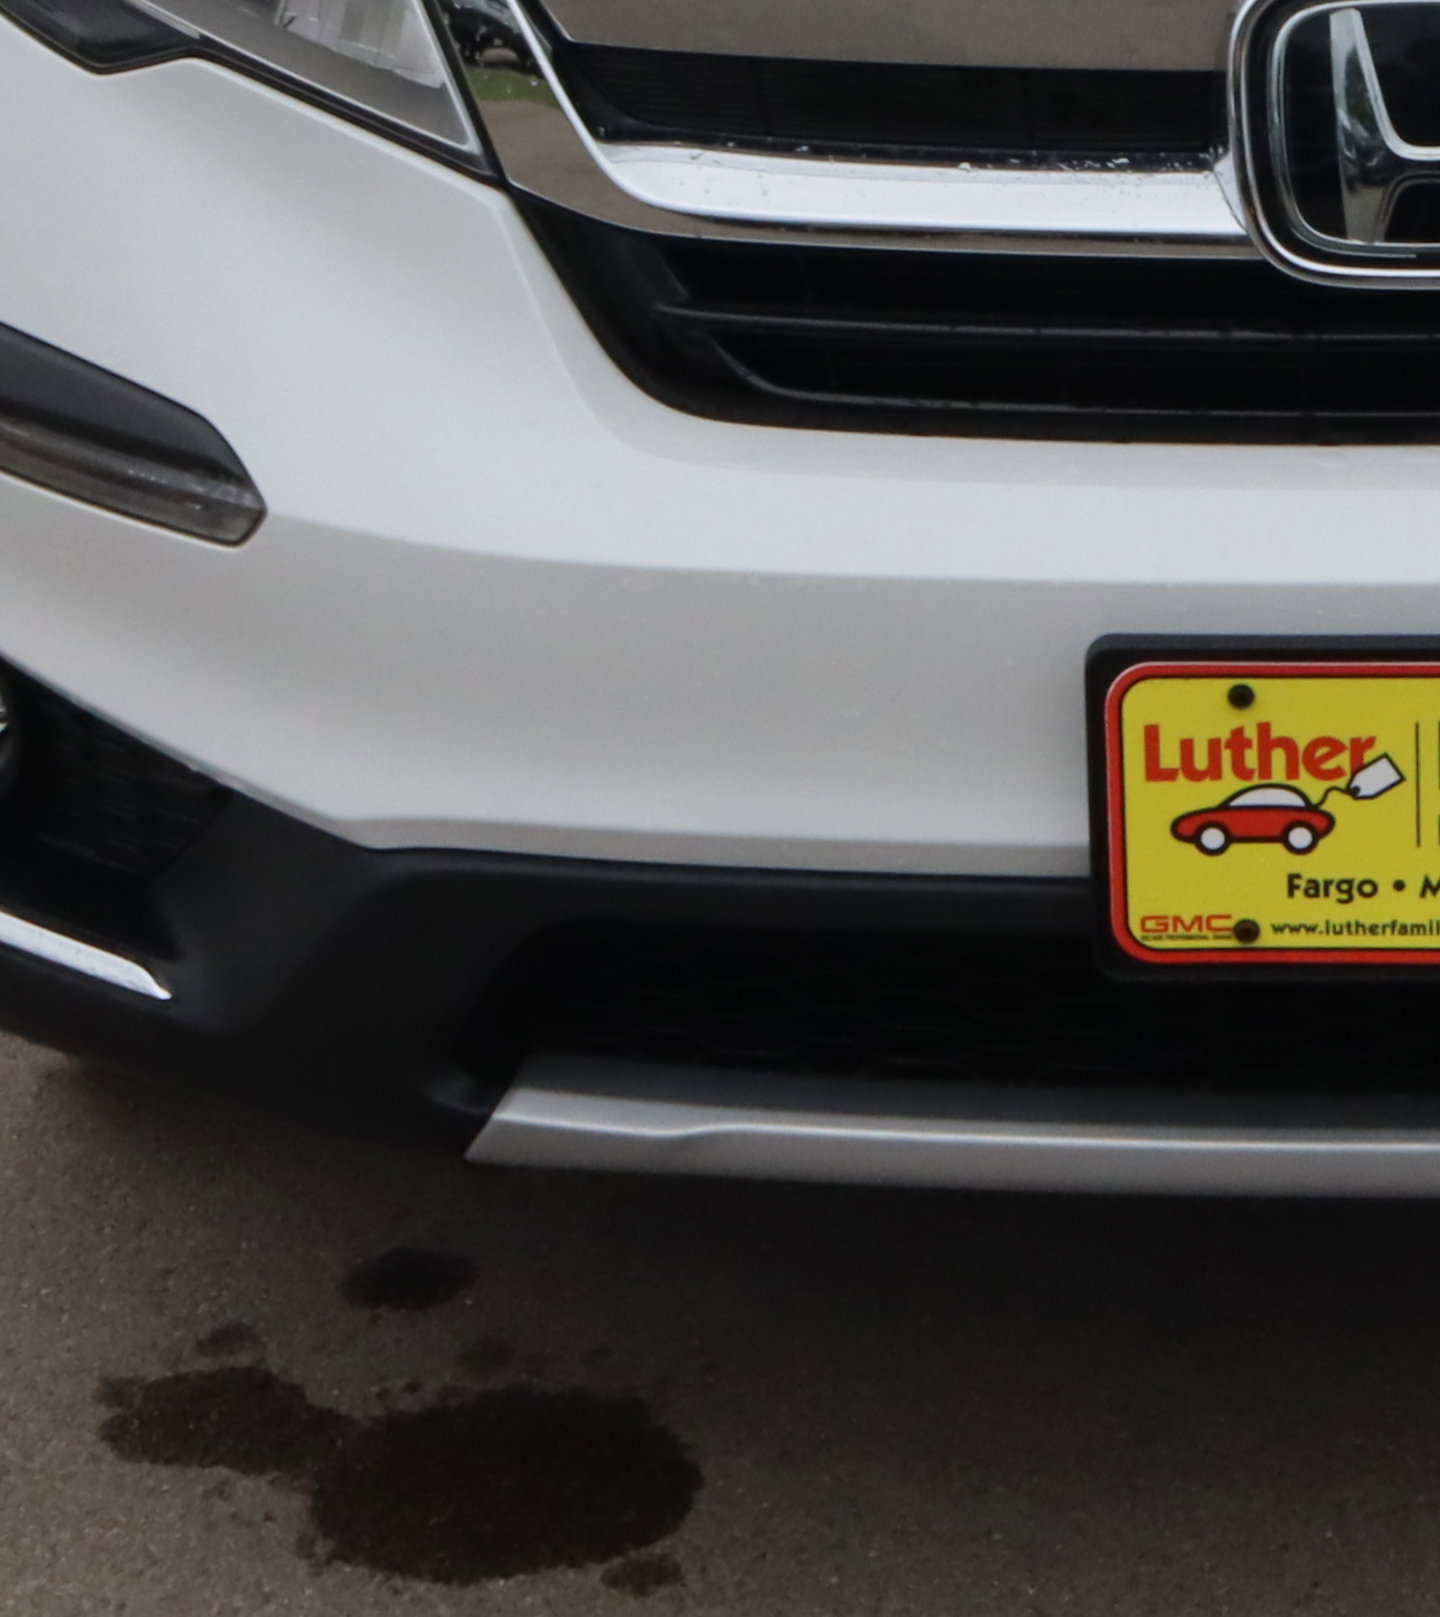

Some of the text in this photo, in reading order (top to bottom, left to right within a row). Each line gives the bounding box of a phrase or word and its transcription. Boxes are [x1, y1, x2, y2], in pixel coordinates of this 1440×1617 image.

[1142, 722, 1377, 783] Luther
[1286, 874, 1379, 904] Fargo
[1140, 914, 1233, 934] GMC
